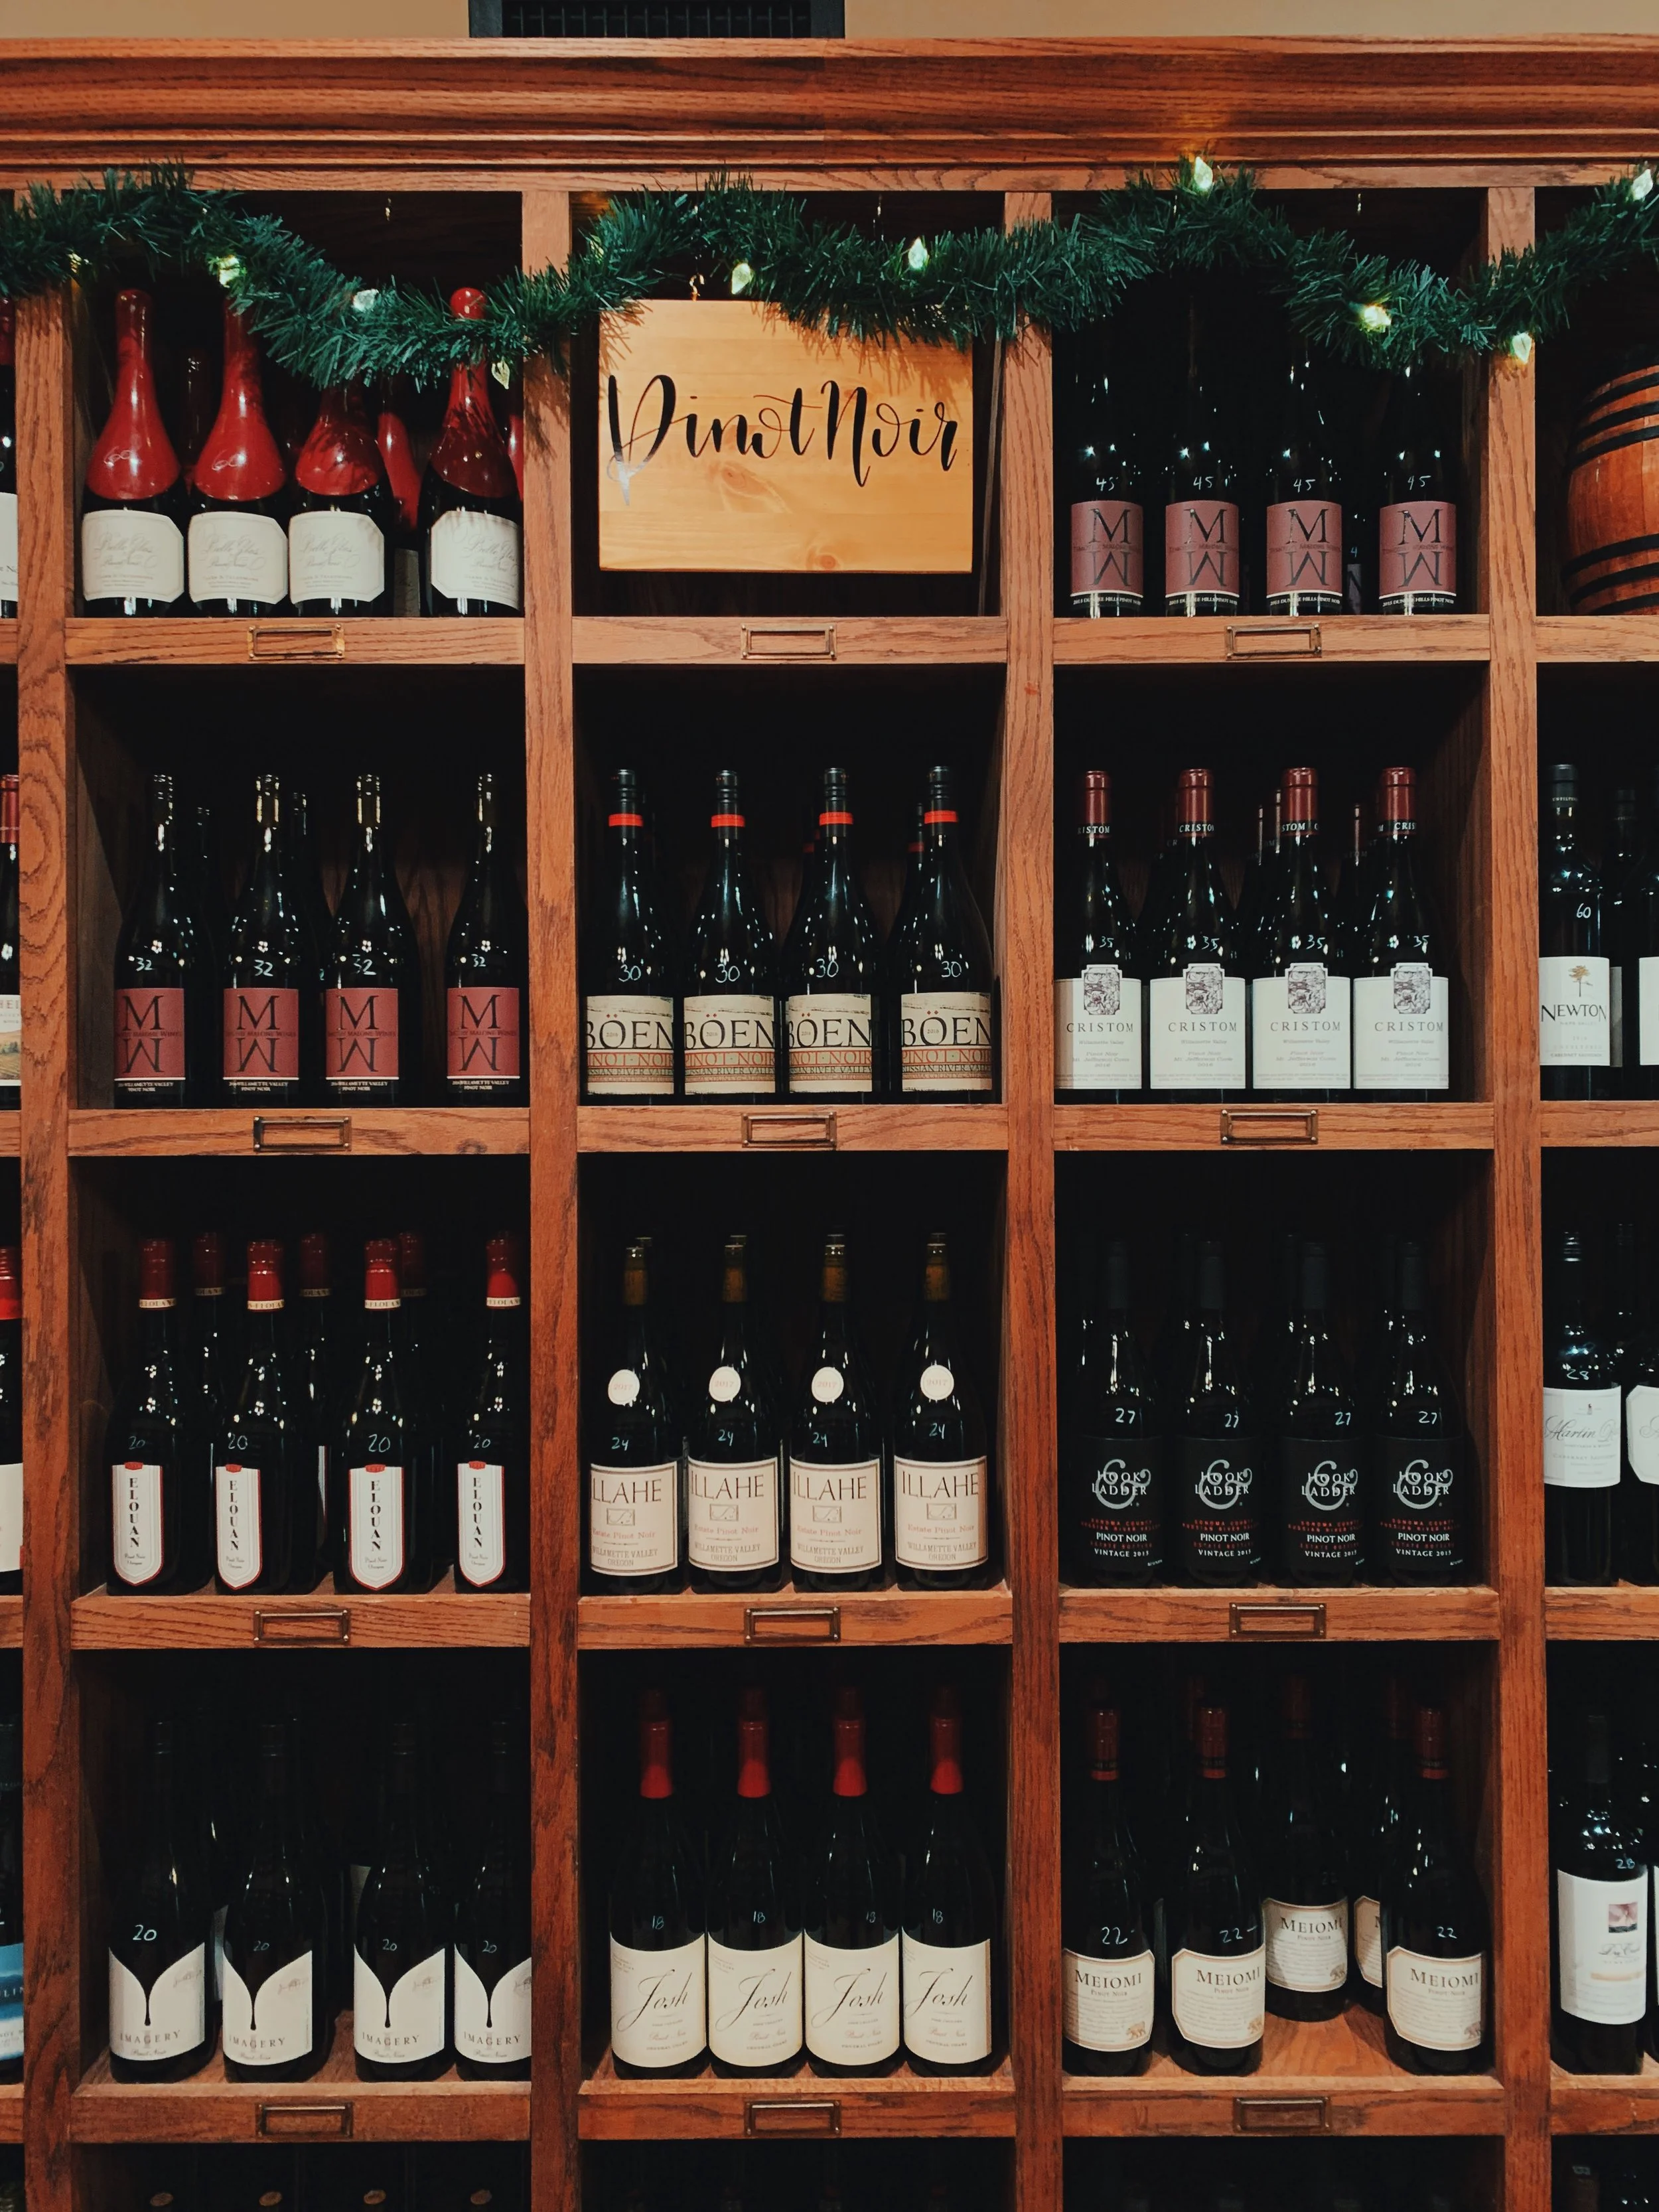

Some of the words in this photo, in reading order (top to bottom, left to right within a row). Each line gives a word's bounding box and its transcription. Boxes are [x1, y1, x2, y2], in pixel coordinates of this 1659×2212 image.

[607, 374, 822, 505] Pinot
[820, 380, 958, 487] Noir
[1096, 476, 1119, 491] 45
[1193, 477, 1214, 490] 45
[1293, 479, 1316, 492] 45
[1407, 475, 1431, 490] 45
[1088, 508, 1131, 544] M
[1183, 508, 1227, 544] M
[1285, 508, 1330, 544] M
[1397, 508, 1444, 545] M
[1077, 825, 1110, 834] RISTOM
[1576, 903, 1591, 919] 60
[1099, 936, 1114, 948] 35
[1202, 936, 1220, 951] 35
[1306, 934, 1325, 950] 35
[1414, 935, 1429, 948] 35
[135, 957, 154, 971] 32
[255, 960, 274, 976] 32
[353, 954, 377, 975] 32
[472, 954, 486, 968] 32
[816, 958, 839, 978] 30
[618, 964, 642, 982] 30
[715, 964, 740, 983] 30
[941, 960, 962, 978] 30
[123, 995, 165, 1031] M
[237, 995, 279, 1030] M
[337, 995, 379, 1030] M
[459, 994, 500, 1029] M
[1542, 1004, 1607, 1022] NEWTON
[1066, 1022, 1133, 1033] CRISTOM
[1168, 1022, 1237, 1032] CRISTOM
[1270, 1021, 1340, 1031] CRISTOM
[1374, 1021, 1443, 1031] CRISTOM
[587, 1053, 626, 1067] INOT
[1567, 1369, 1589, 1380] 28
[1116, 1408, 1135, 1424] 27
[1225, 1413, 1240, 1428] 27
[1334, 1412, 1351, 1426] 27
[1418, 1411, 1437, 1424] 27
[930, 1424, 945, 1439] 24
[1544, 1415, 1595, 1441] Martin
[129, 1436, 145, 1449] 20
[228, 1436, 248, 1449] 20
[368, 1434, 390, 1452] 20
[474, 1436, 491, 1449] 20
[611, 1437, 628, 1451] 24
[719, 1430, 733, 1445] 24
[813, 1433, 828, 1447] 24
[1097, 1471, 1142, 1483] HOOK
[1200, 1471, 1245, 1483] HOOK
[1307, 1472, 1352, 1483] HOOK
[1398, 1471, 1445, 1483] HOOK
[592, 1478, 662, 1504] LLAHE
[691, 1474, 764, 1500] ILLAHE
[794, 1471, 867, 1501] ILLAHE
[902, 1471, 979, 1499] ILLAHE
[1091, 1485, 1147, 1496] LADDER
[1194, 1485, 1250, 1496] LADDER
[1301, 1486, 1356, 1498] LADDER
[1393, 1484, 1450, 1496] LADDER
[129, 1477, 140, 1548] ELOUAN
[230, 1480, 239, 1551] ELOUAN
[370, 1481, 382, 1552] ELOUAN
[473, 1477, 482, 1548] ELOUAN
[1096, 1532, 1125, 1542] PINOT
[1127, 1534, 1147, 1542] NOIR
[1200, 1534, 1228, 1542] PINOT
[1230, 1532, 1250, 1542] NOIR
[1307, 1534, 1335, 1543] PINOT
[1337, 1533, 1356, 1542] NOIR
[1398, 1532, 1427, 1542] PINOT
[1428, 1533, 1451, 1542] NOIR
[630, 1548, 658, 1558] VALLEY
[733, 1544, 760, 1554] VALLEY
[835, 1545, 863, 1555] VALLEY
[907, 1541, 951, 1554] WILLAMETTE
[953, 1541, 977, 1552] VALLEY
[1094, 1548, 1129, 1558] VINTAGE
[1198, 1548, 1234, 1557] VINTAGE
[1396, 1548, 1432, 1557] VINTAGE
[608, 1558, 634, 1567] OREGON
[652, 1916, 664, 1929] 18
[754, 1911, 765, 1923] 18
[866, 1911, 875, 1923] 18
[932, 1909, 943, 1923] 18
[1280, 1917, 1342, 1934] MEIOMI
[1437, 1926, 1457, 1939] 22
[133, 1925, 157, 1941] 20
[253, 1941, 269, 1951] 20
[383, 1939, 397, 1951] 20
[482, 1941, 497, 1953] 20
[1074, 1969, 1141, 1989] MEIOMI
[1196, 1966, 1260, 1986] MEIOMI
[1410, 1968, 1479, 1988] MEIOMI
[617, 1968, 692, 2031] Josh
[715, 1968, 792, 2031] Josh
[811, 1968, 887, 2028] Josh
[904, 1968, 973, 2019] Josh
[120, 2029, 179, 2043] IMAGERY
[230, 2037, 285, 2049] IMAGERY
[362, 2032, 419, 2046] IMAGERY
[464, 2031, 521, 2045] IMAGERY
